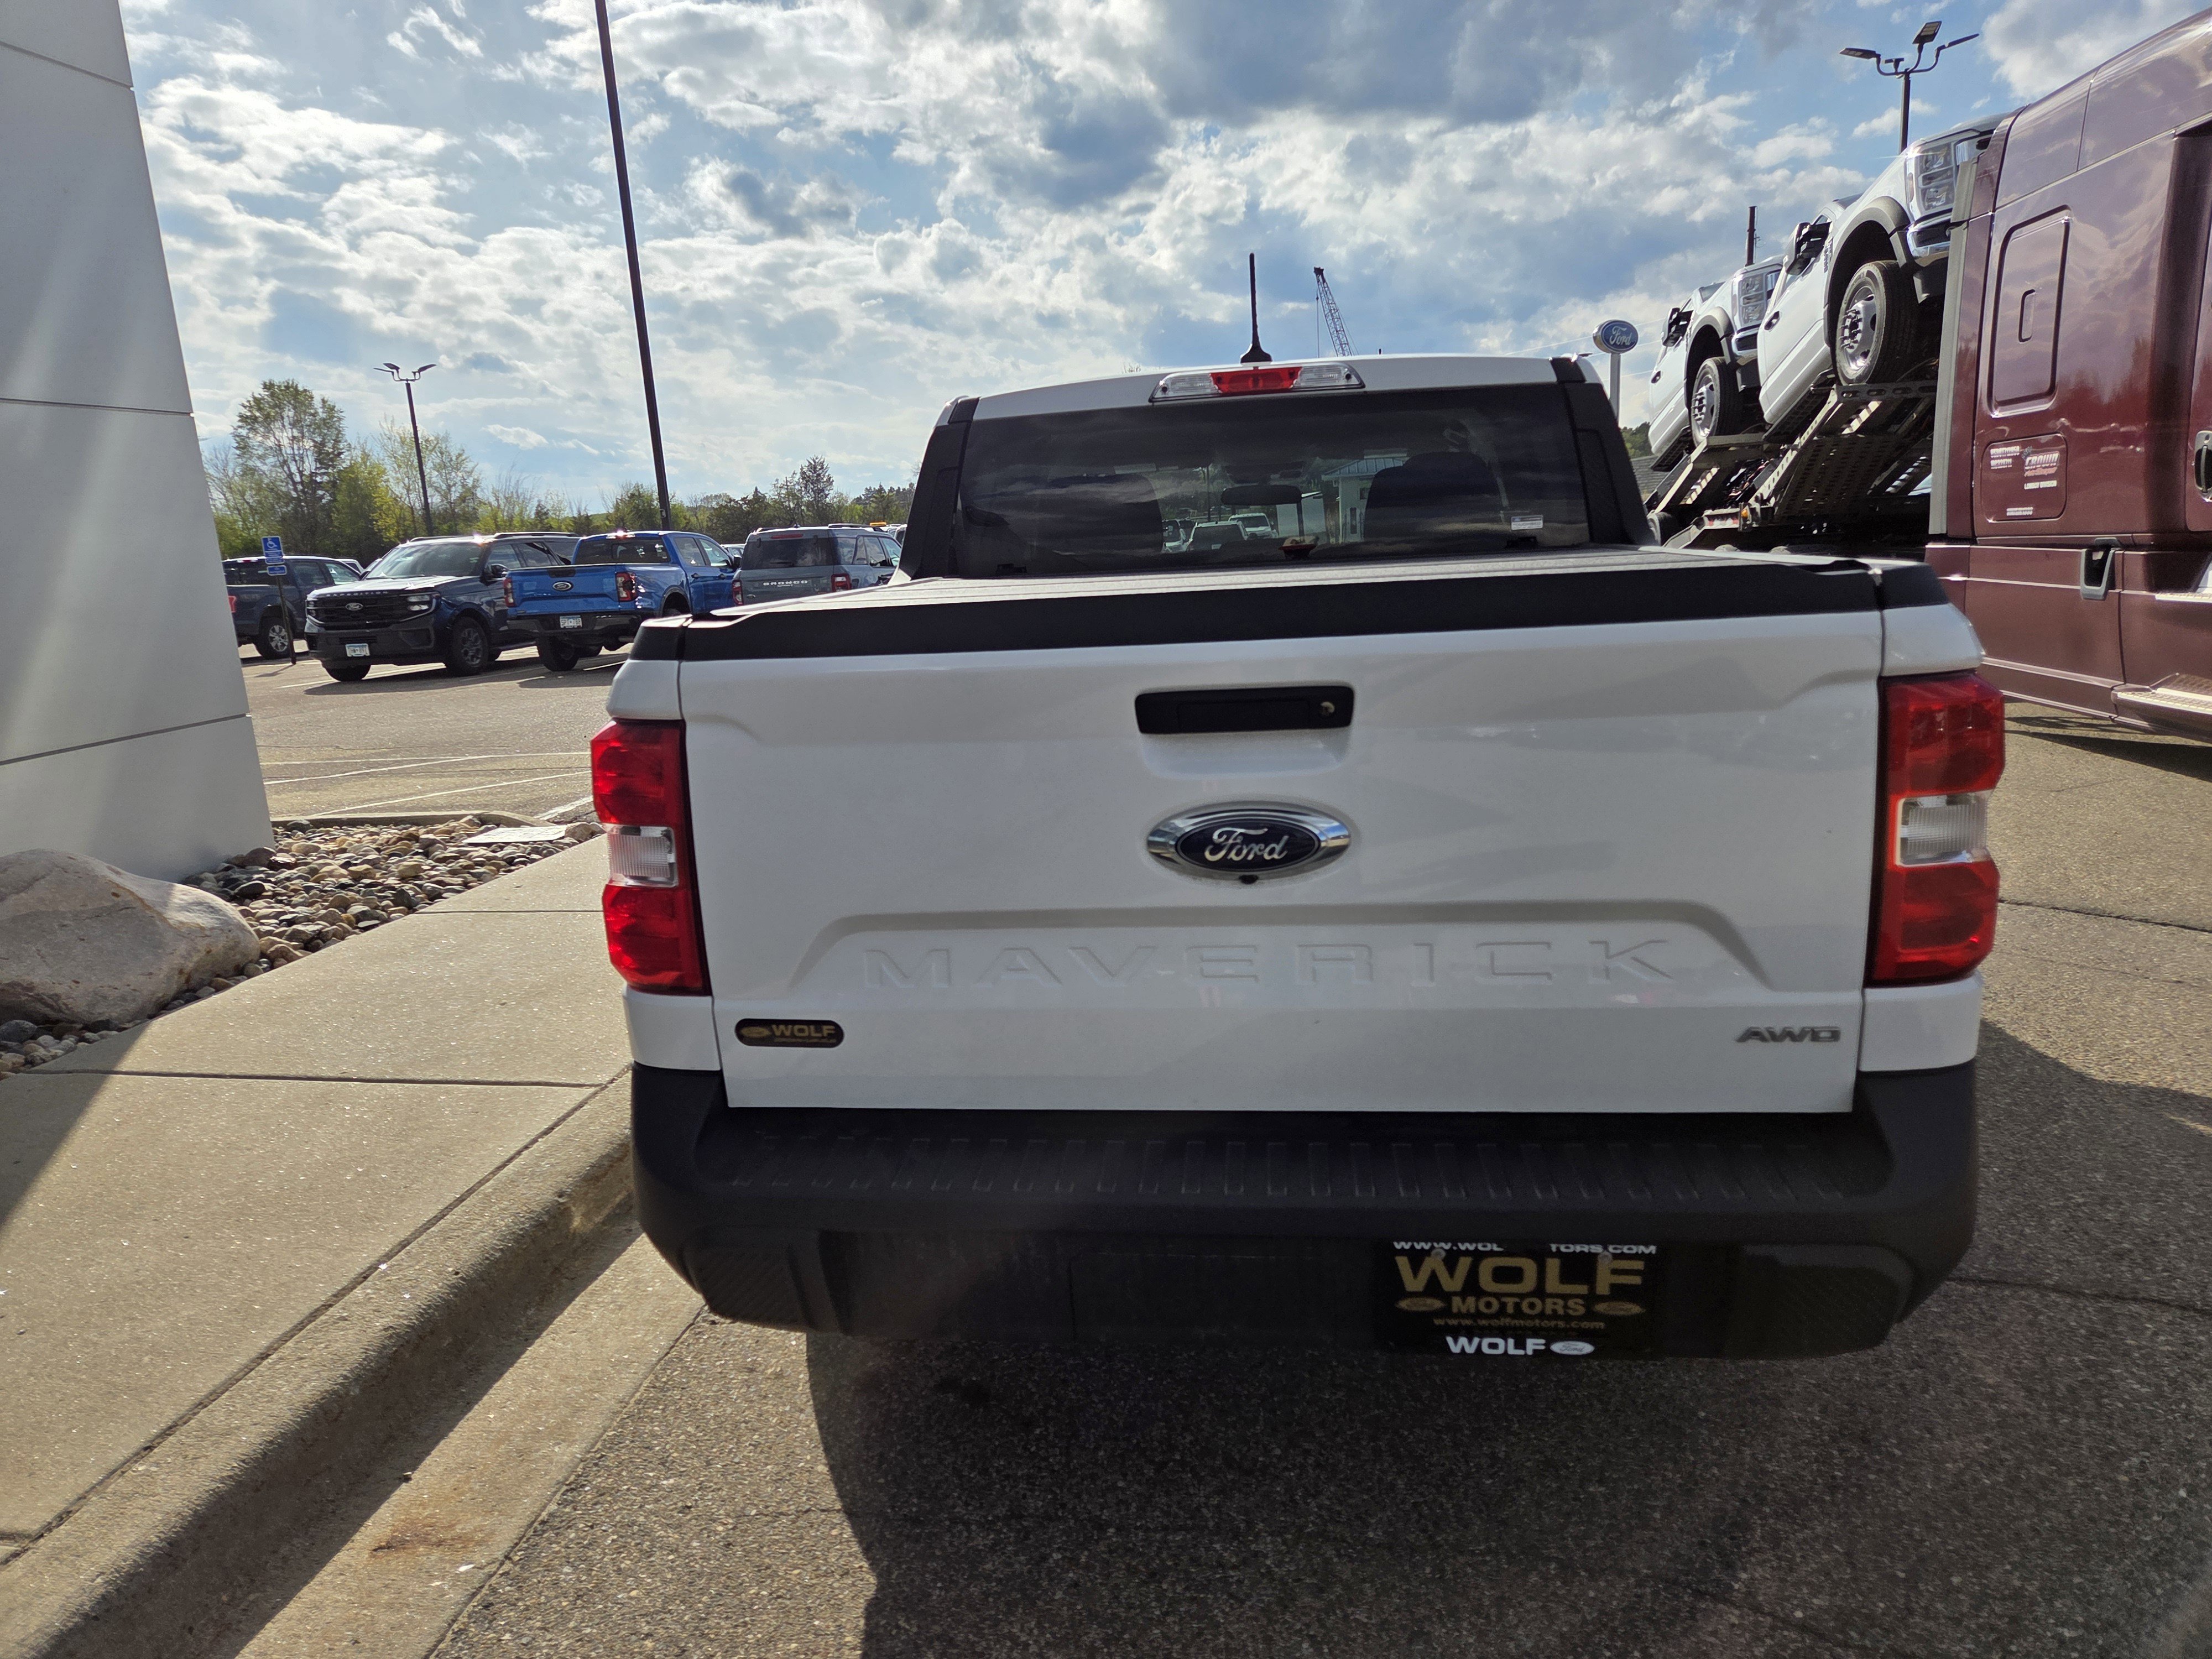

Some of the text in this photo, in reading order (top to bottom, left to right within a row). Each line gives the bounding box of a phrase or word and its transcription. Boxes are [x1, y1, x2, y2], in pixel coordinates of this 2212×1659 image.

[1609, 326, 1632, 346] Ford
[1204, 826, 1290, 862] Ford
[862, 938, 1676, 990] MAVERICK
[772, 1024, 836, 1037] WOLF
[1735, 1026, 1841, 1042] AWD
[1394, 1255, 1645, 1295] WOLF
[1451, 1296, 1586, 1317] MOTORS
[1433, 1317, 1606, 1329] www.wolfmotors.com
[1445, 1335, 1546, 1355] WOLF
[1559, 1343, 1587, 1353] Ford
